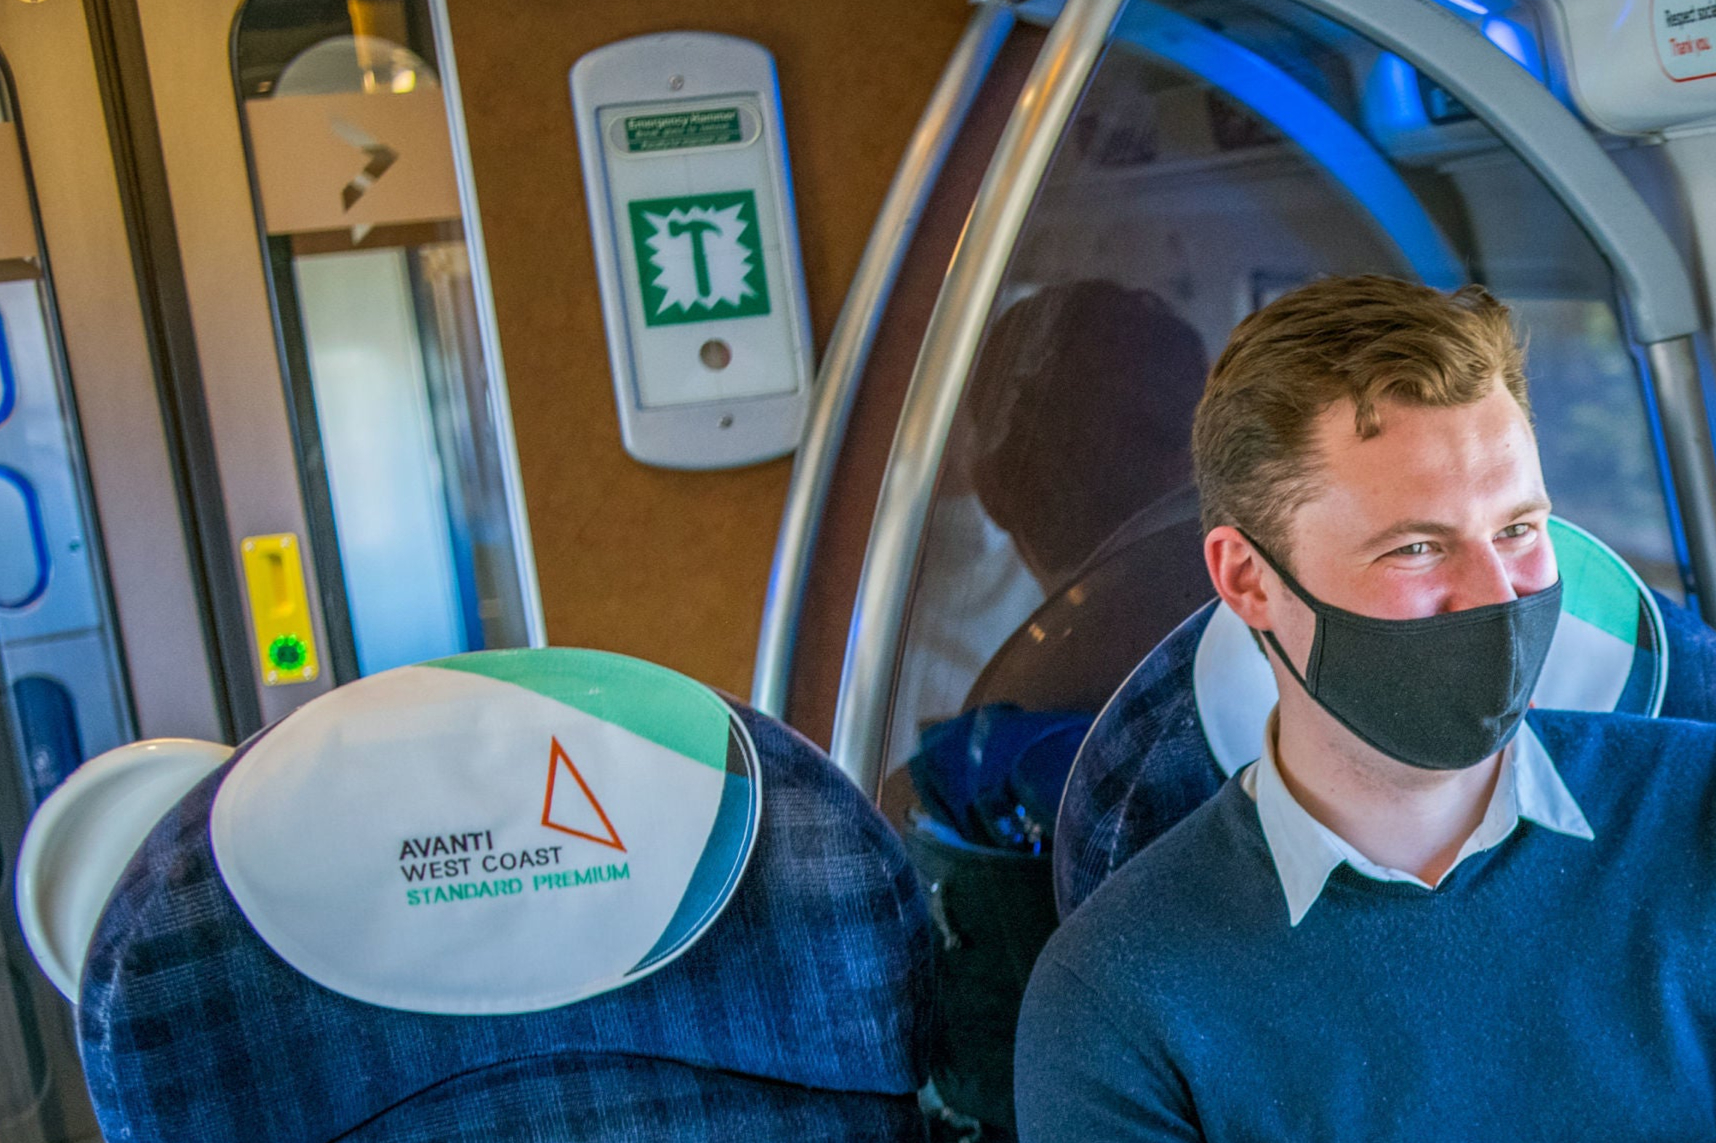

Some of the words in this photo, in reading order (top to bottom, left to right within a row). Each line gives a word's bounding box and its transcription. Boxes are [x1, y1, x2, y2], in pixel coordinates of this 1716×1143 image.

[1669, 36, 1693, 56] Thank
[399, 830, 494, 861] AVANTI
[401, 858, 471, 882] WEST
[482, 846, 563, 873] COAST
[406, 878, 523, 906] STANDARD
[533, 862, 631, 891] PREMIUM
